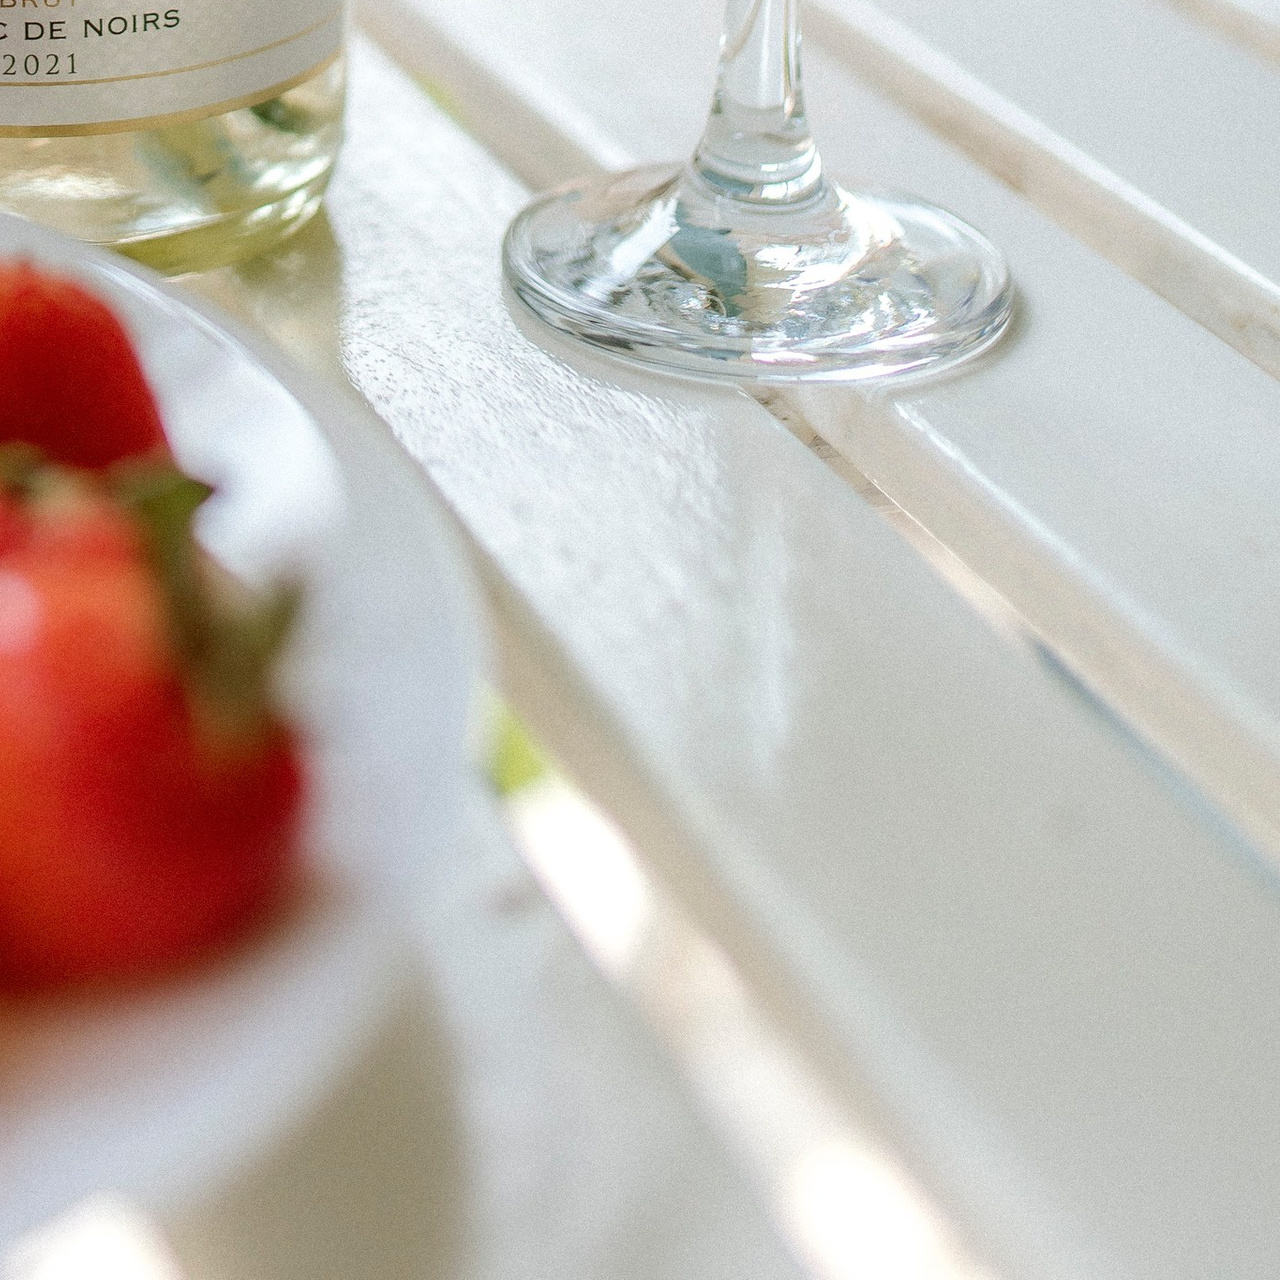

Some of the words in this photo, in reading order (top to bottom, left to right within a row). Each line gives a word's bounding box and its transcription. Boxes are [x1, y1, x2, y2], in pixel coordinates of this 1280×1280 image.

[24, 20, 67, 41] DE
[83, 9, 181, 39] NOIRS
[2, 53, 79, 77] 2021
